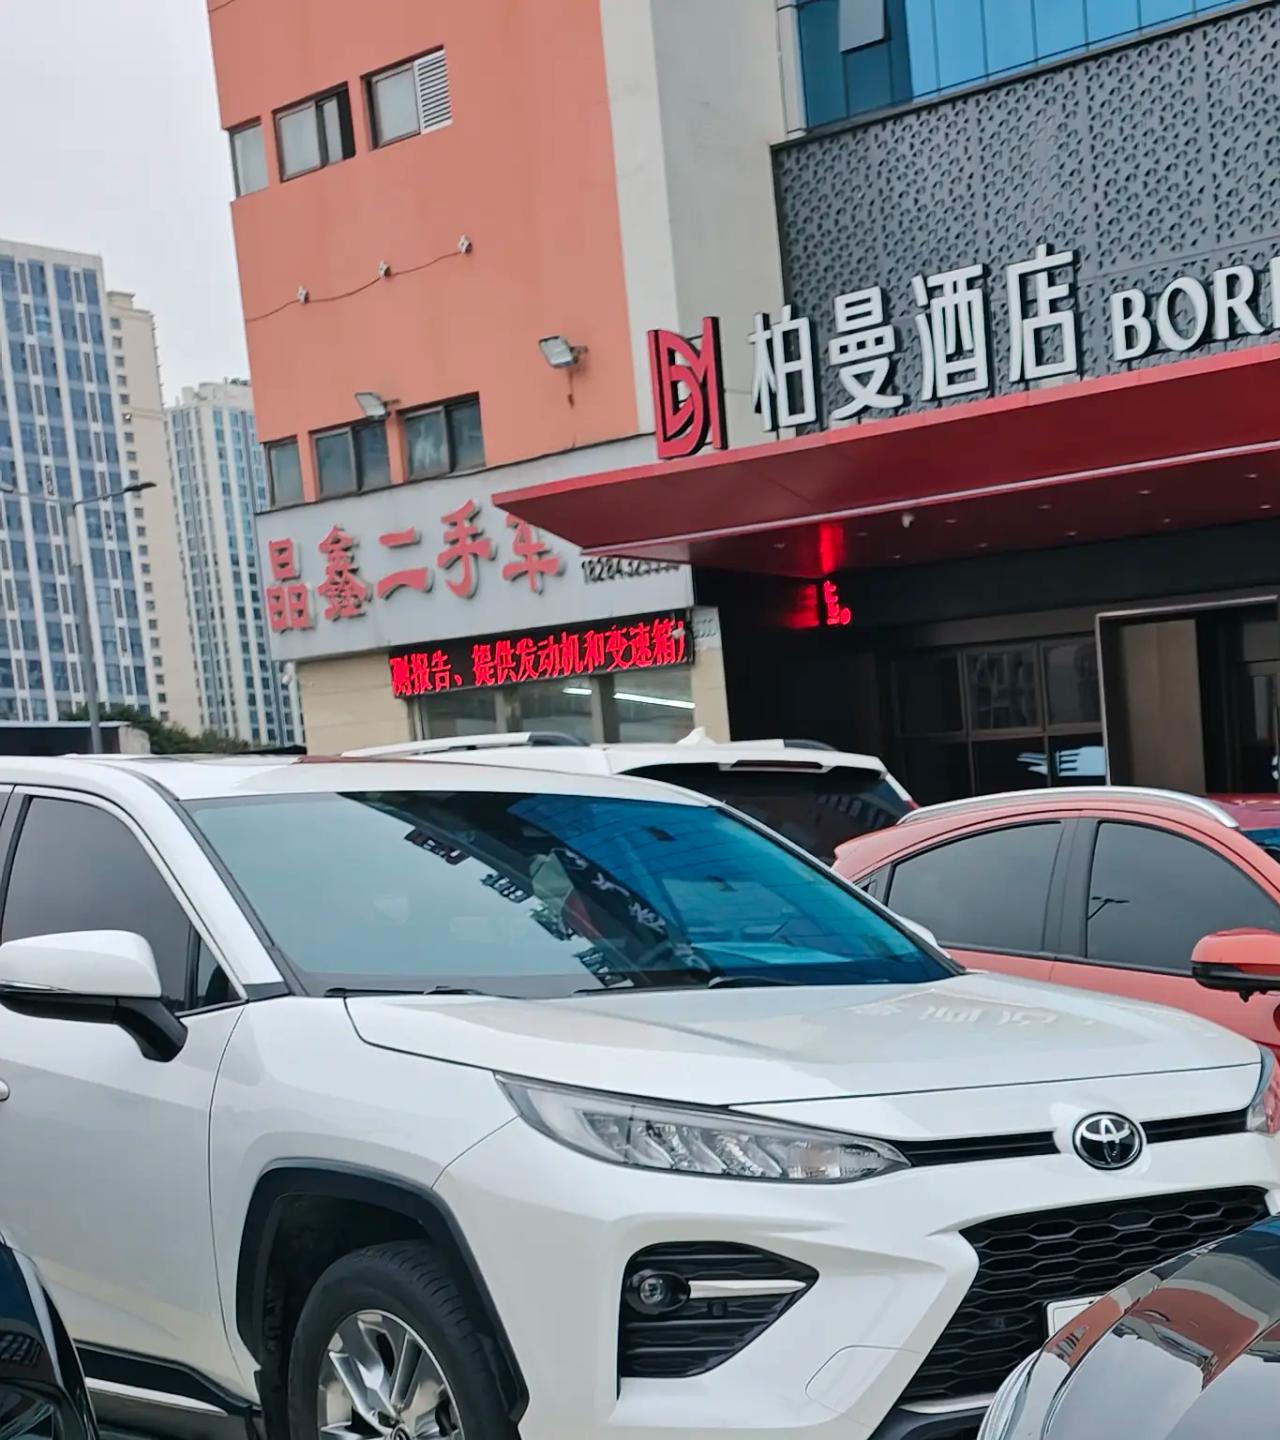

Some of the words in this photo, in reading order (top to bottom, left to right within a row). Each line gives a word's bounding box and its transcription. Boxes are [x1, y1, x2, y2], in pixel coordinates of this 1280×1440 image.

[748, 243, 1080, 432] 柏曼酒店
[266, 499, 564, 633] 晶鑫二手车
